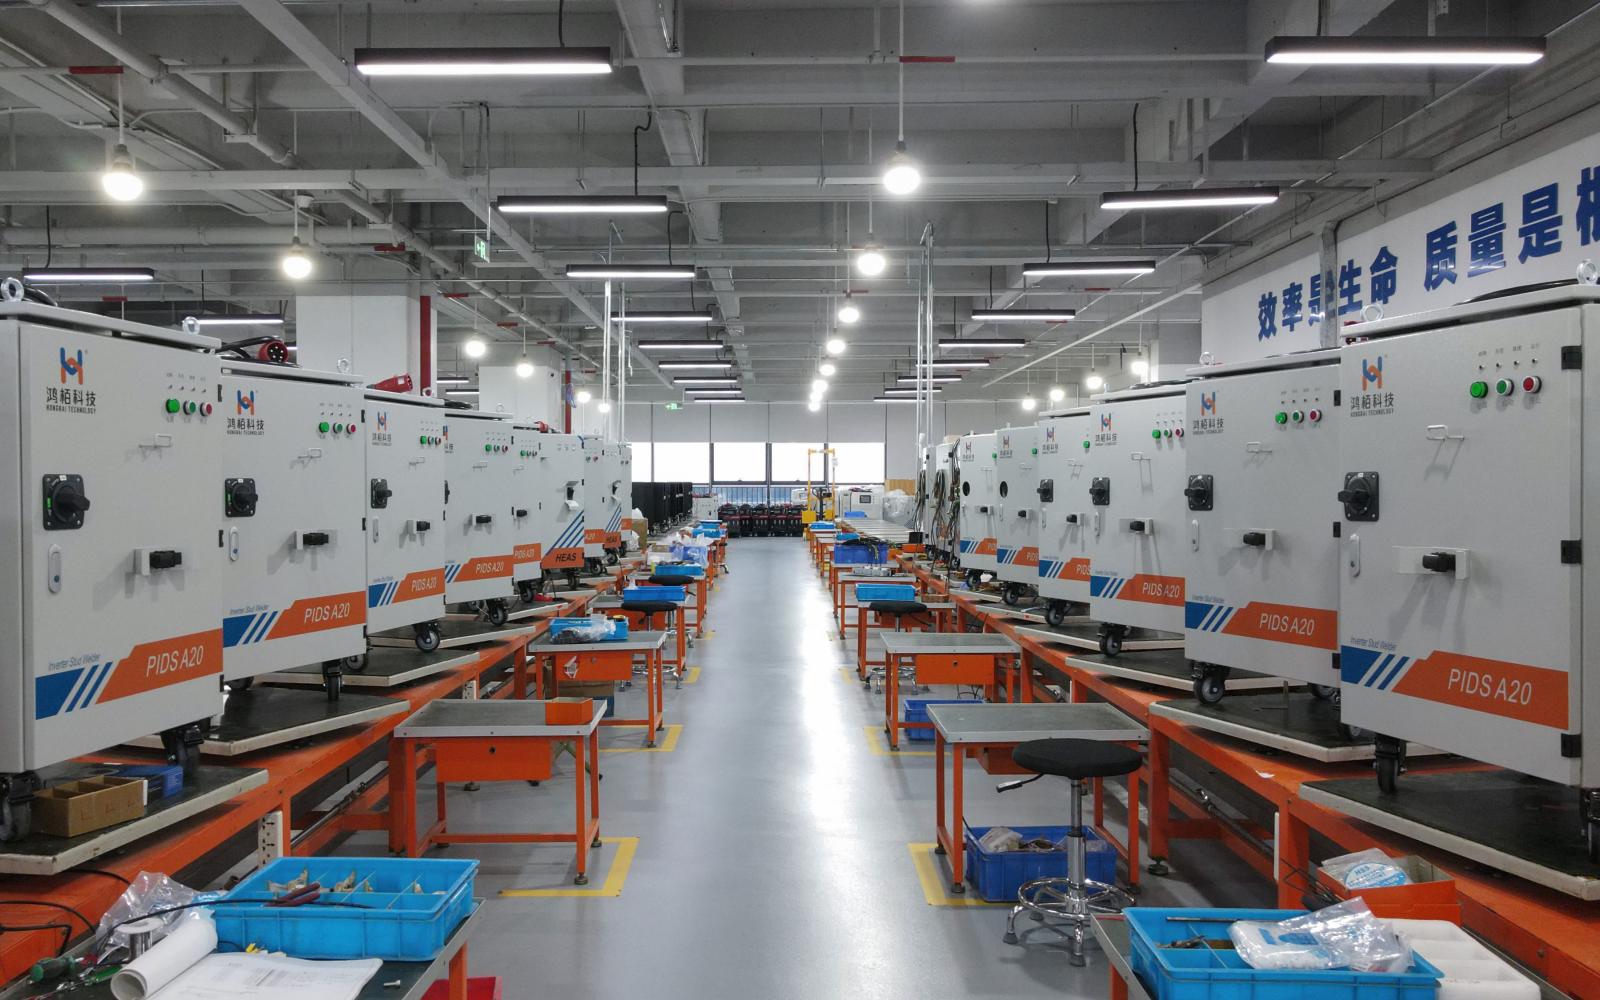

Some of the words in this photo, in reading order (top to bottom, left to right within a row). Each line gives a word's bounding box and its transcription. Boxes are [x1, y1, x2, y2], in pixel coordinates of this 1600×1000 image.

[555, 551, 577, 563] HEAS
[476, 561, 492, 575] PIDS
[492, 560, 505, 573] A20
[412, 578, 426, 592] PIDS
[426, 576, 437, 590] A20
[1142, 582, 1163, 597] PIDS
[1163, 584, 1180, 598] A20
[304, 605, 330, 624] PIDS
[331, 602, 351, 620] A20
[1259, 612, 1289, 632] PIDS
[1289, 618, 1315, 636] A20
[146, 653, 178, 678] PIDS
[182, 645, 204, 669] A20
[1448, 668, 1493, 697] PIDS
[1494, 677, 1533, 706] A20
